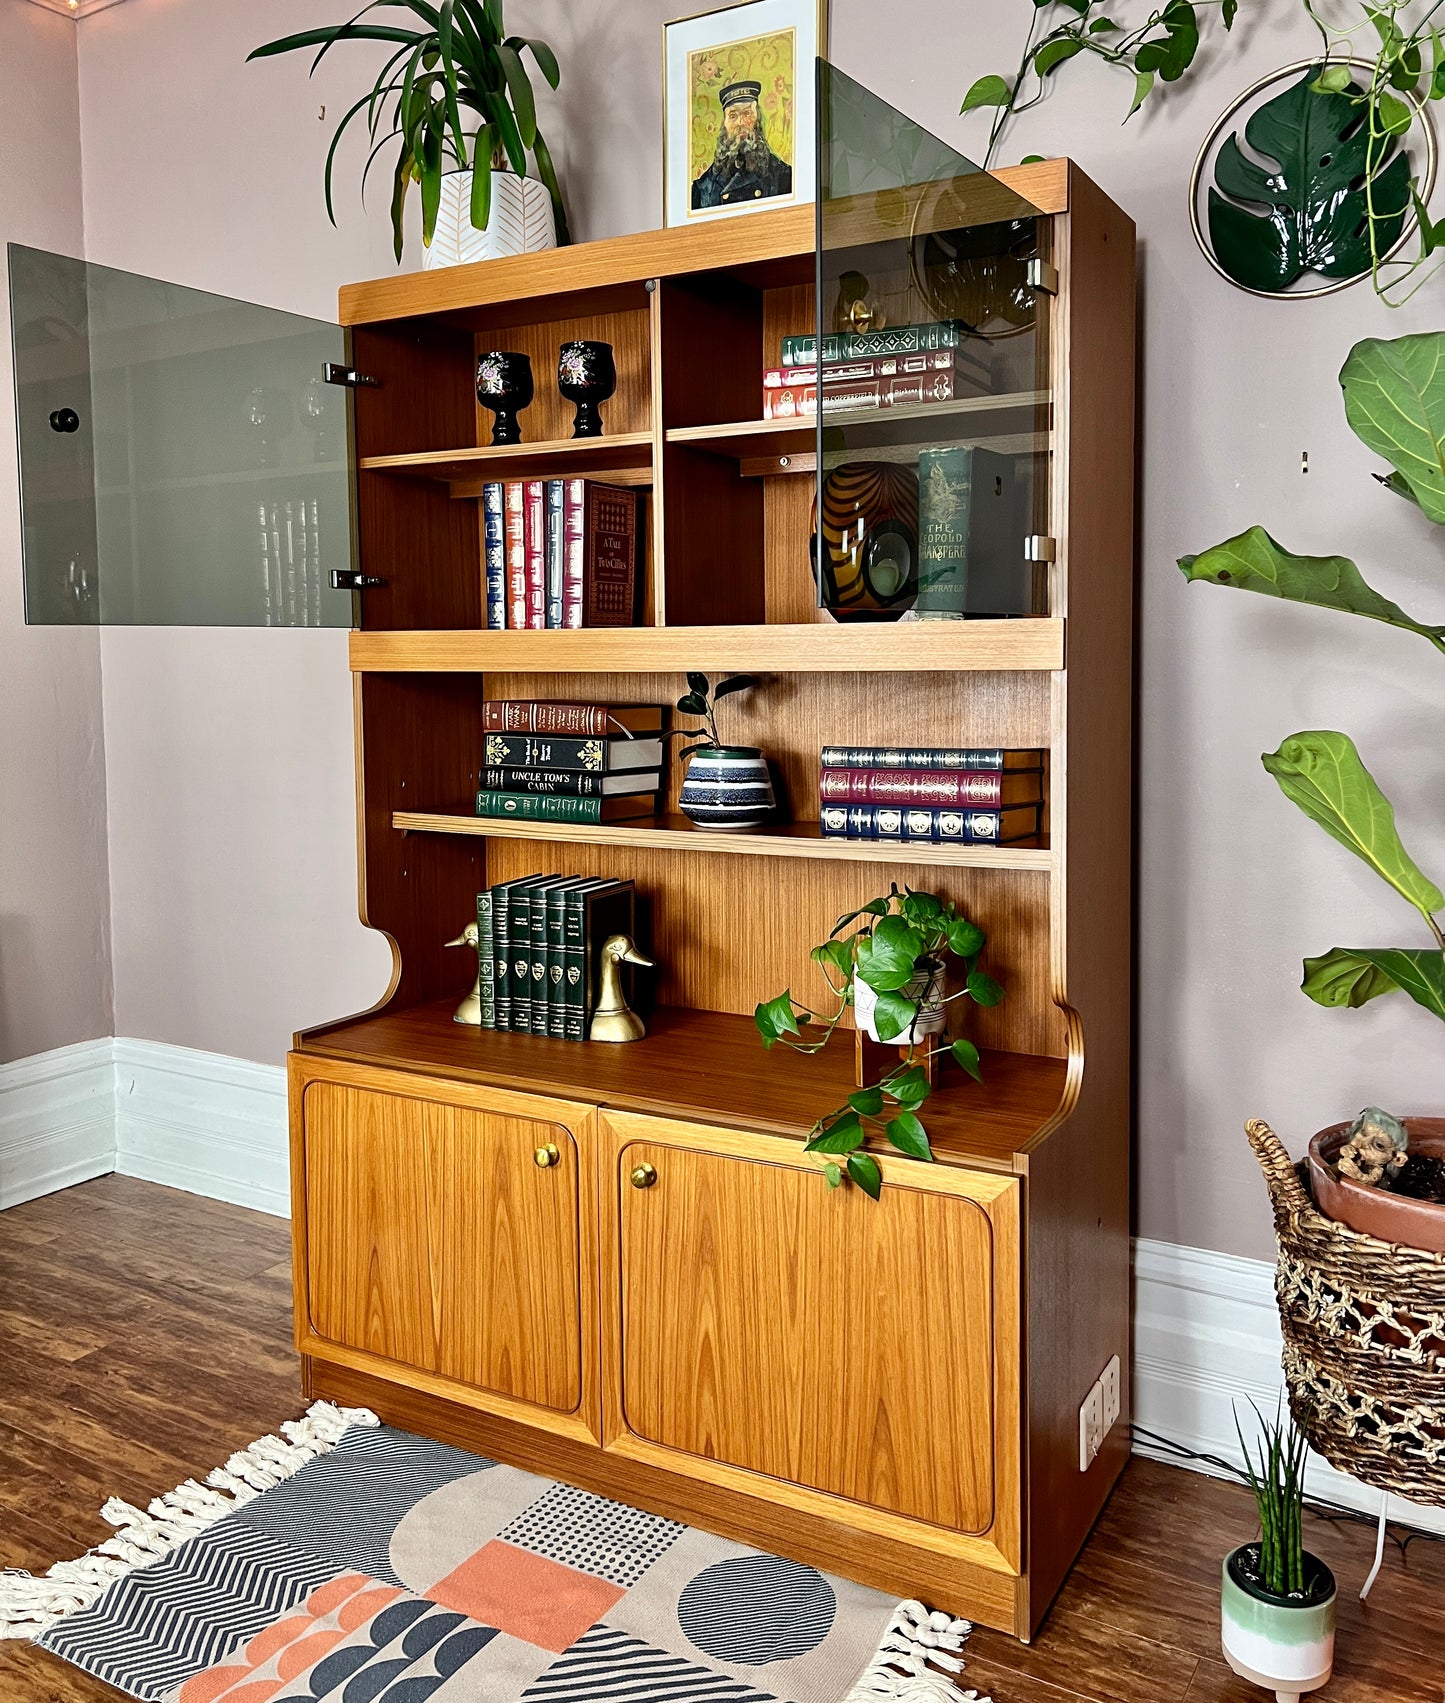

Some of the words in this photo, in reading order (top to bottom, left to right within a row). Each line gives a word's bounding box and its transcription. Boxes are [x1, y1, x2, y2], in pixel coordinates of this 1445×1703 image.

[926, 523, 954, 534] THE
[603, 538, 609, 548] A
[919, 544, 967, 561] HAKSPERE
[511, 771, 541, 783] UNCLE
[543, 773, 571, 784] TOM'S
[527, 782, 555, 792] CABIN
